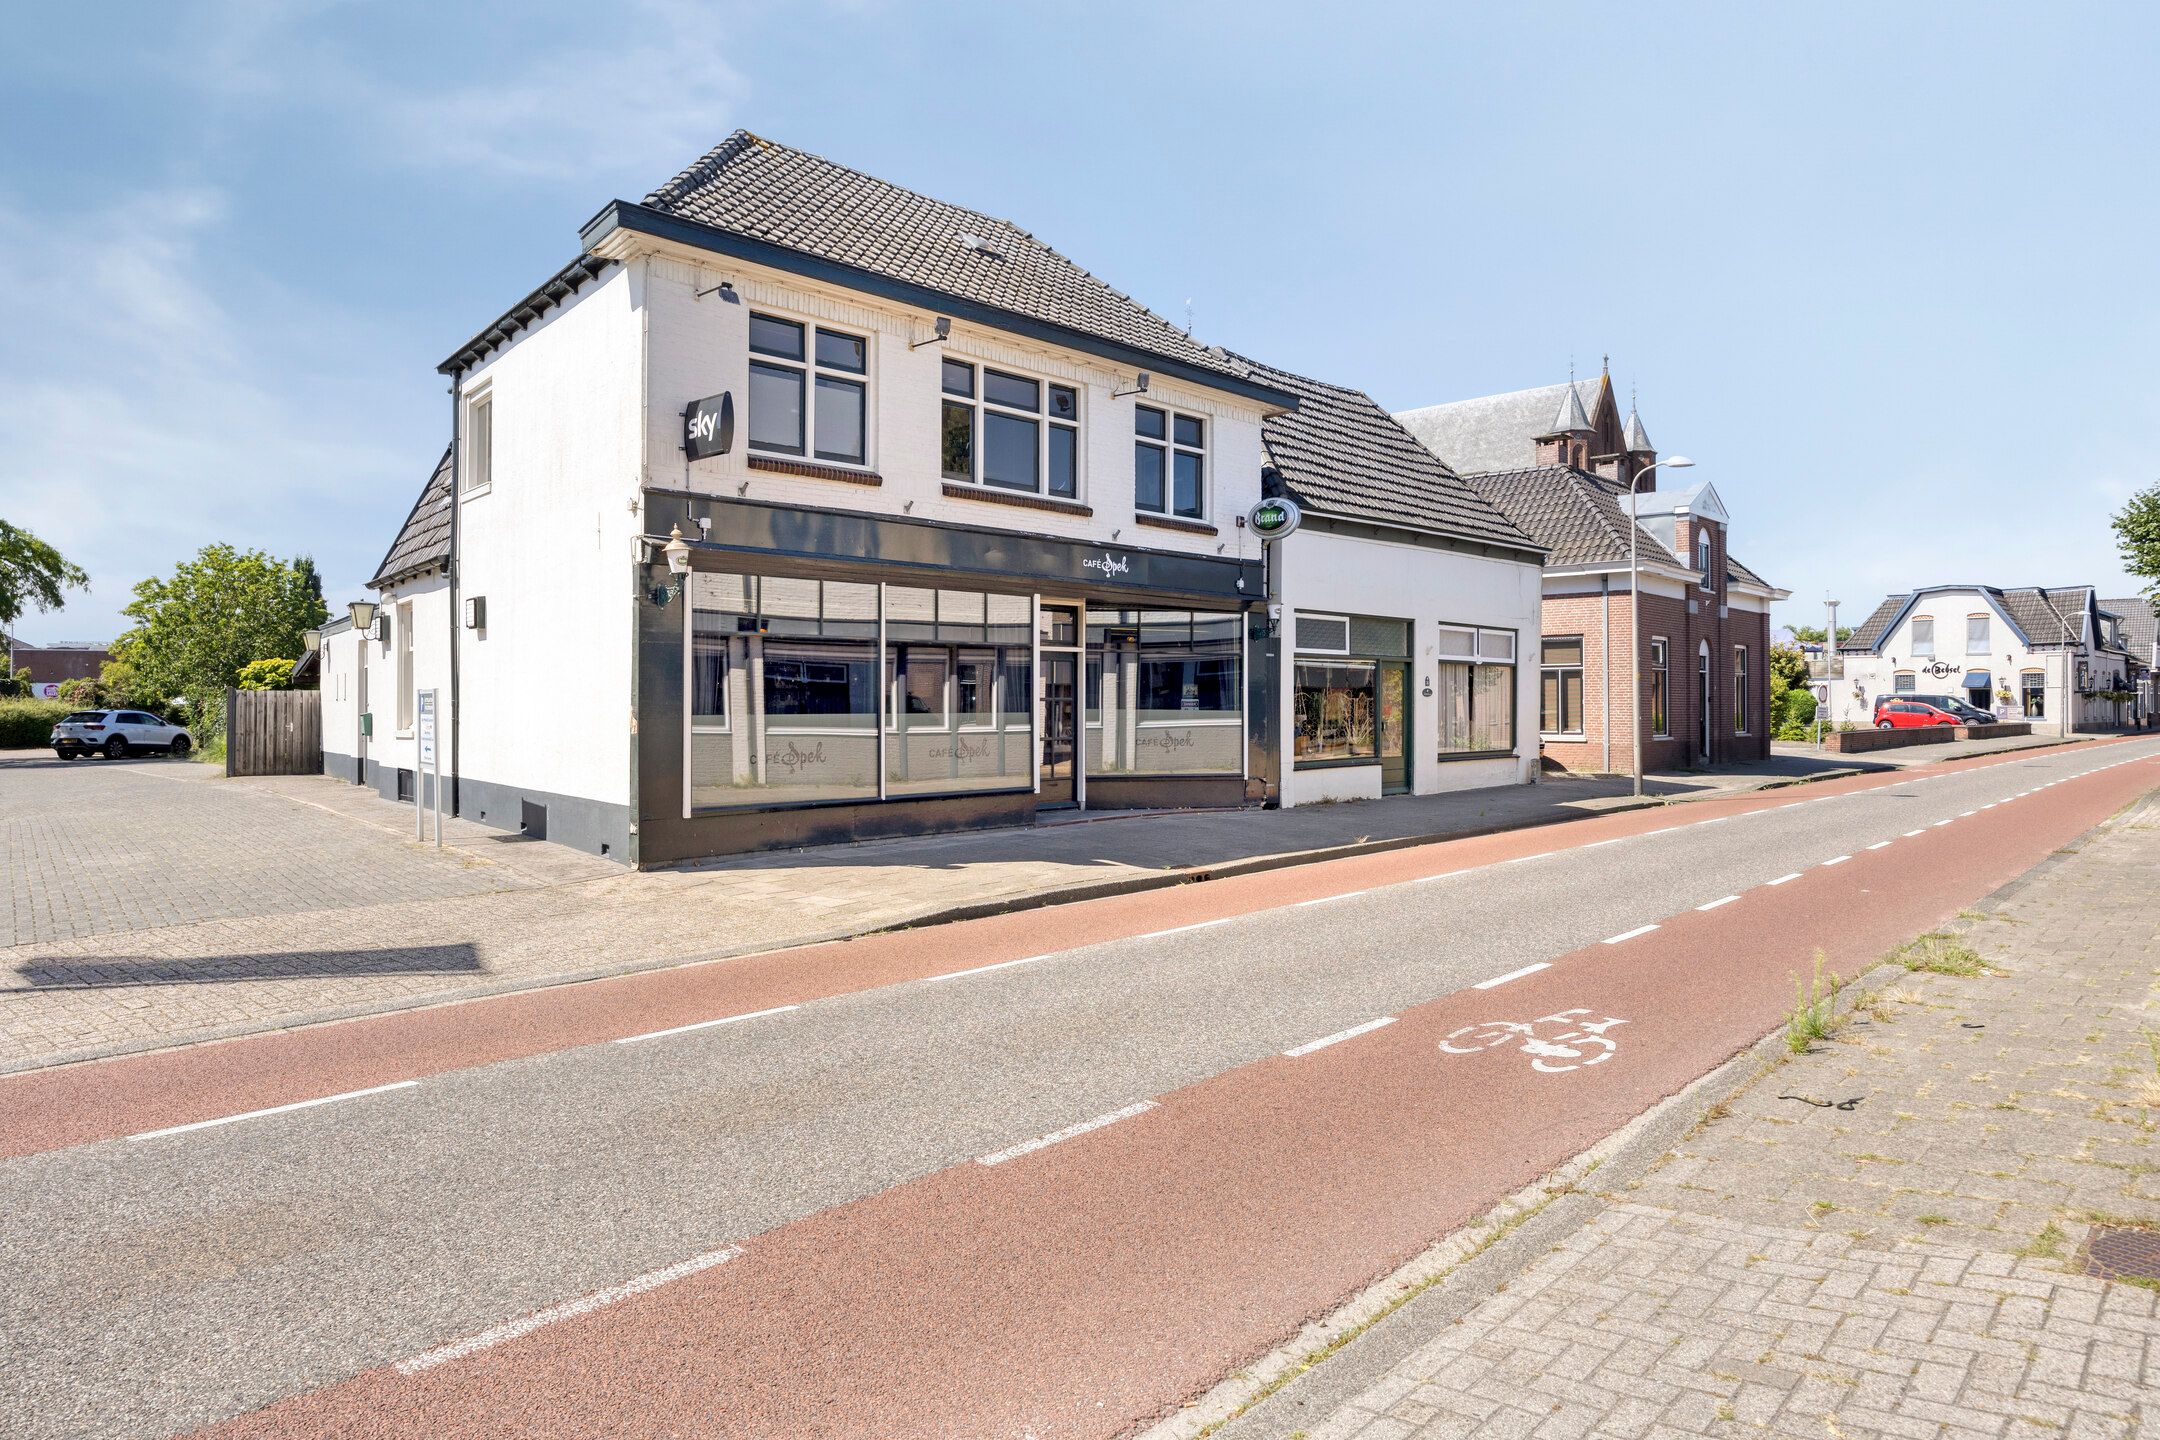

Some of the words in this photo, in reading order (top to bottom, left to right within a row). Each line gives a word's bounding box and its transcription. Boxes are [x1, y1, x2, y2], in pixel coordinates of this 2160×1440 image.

[688, 410, 718, 442] sky
[1254, 511, 1285, 525] Brand
[1082, 559, 1102, 569] CAFÉ
[1102, 552, 1129, 578] Spek
[750, 751, 781, 764] CFÉ
[781, 741, 827, 774] Spek
